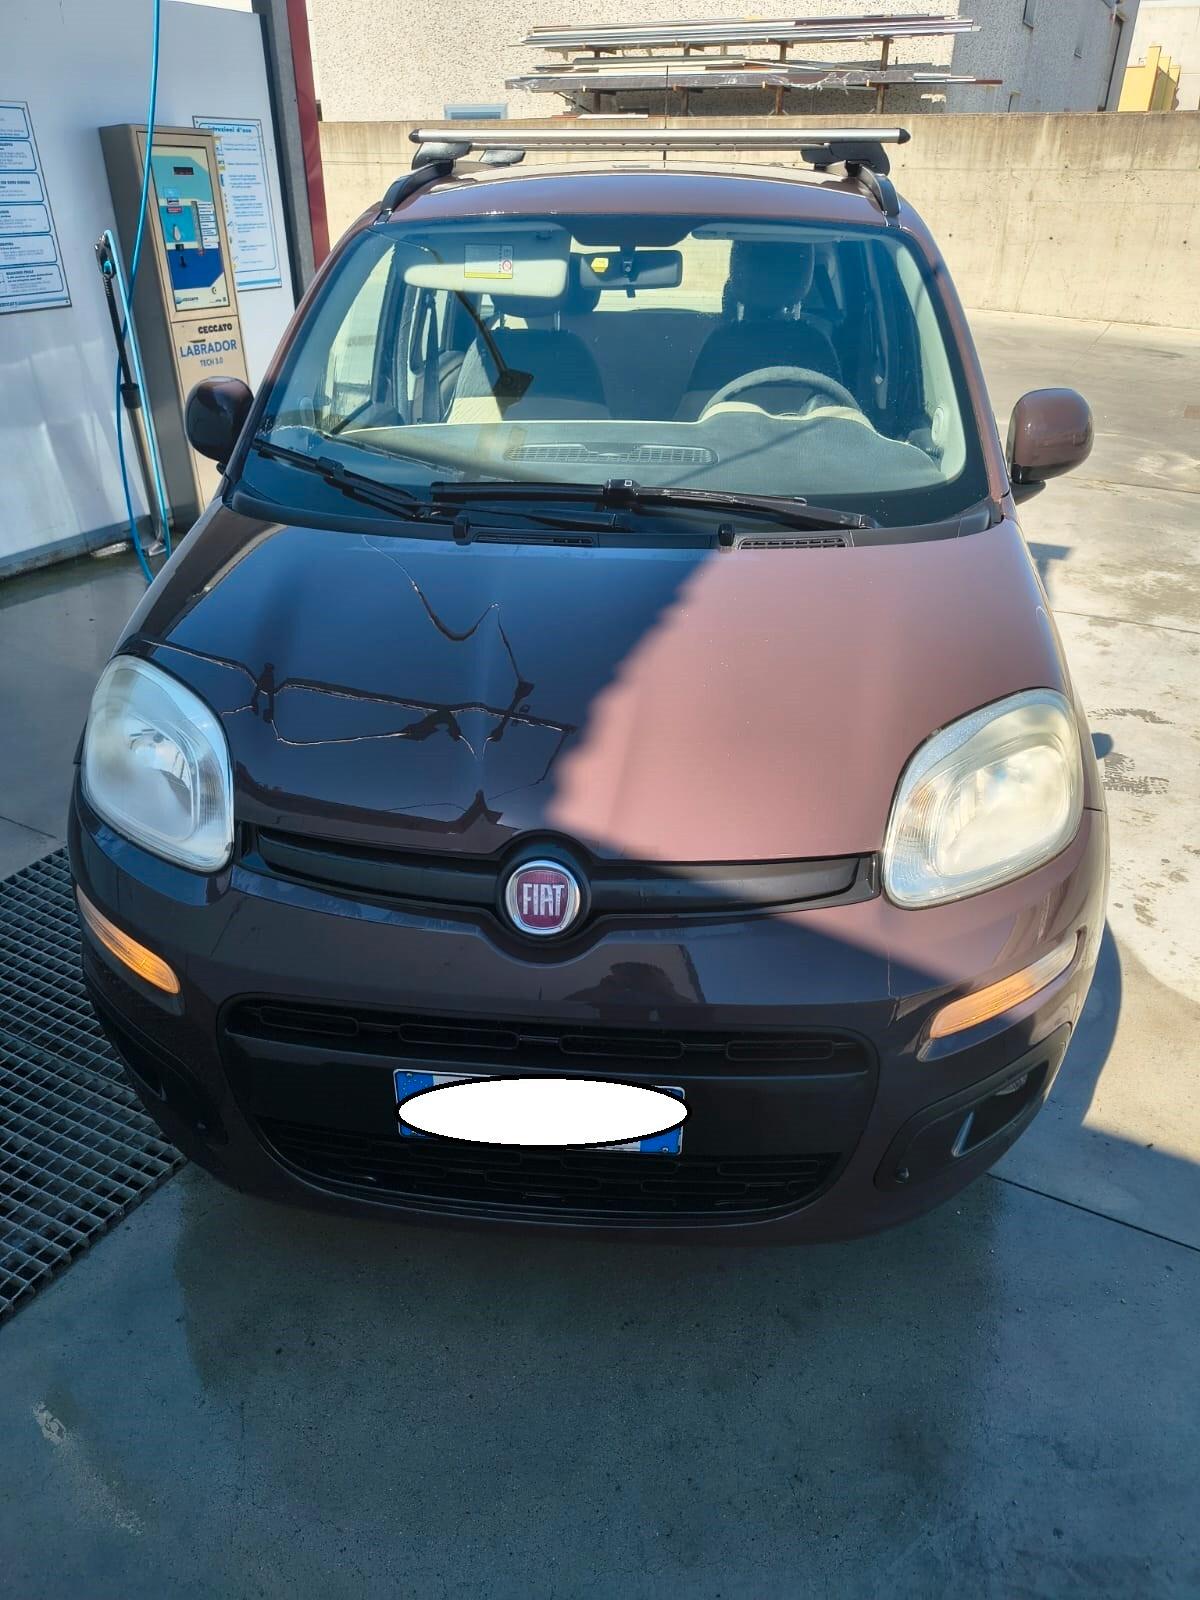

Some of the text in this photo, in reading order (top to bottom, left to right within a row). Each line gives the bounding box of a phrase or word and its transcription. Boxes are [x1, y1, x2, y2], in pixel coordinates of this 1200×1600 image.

[198, 323, 233, 334] CECCATO
[180, 339, 237, 358] LABRADOR
[200, 358, 215, 367] TECH
[522, 883, 565, 916] FIAT
